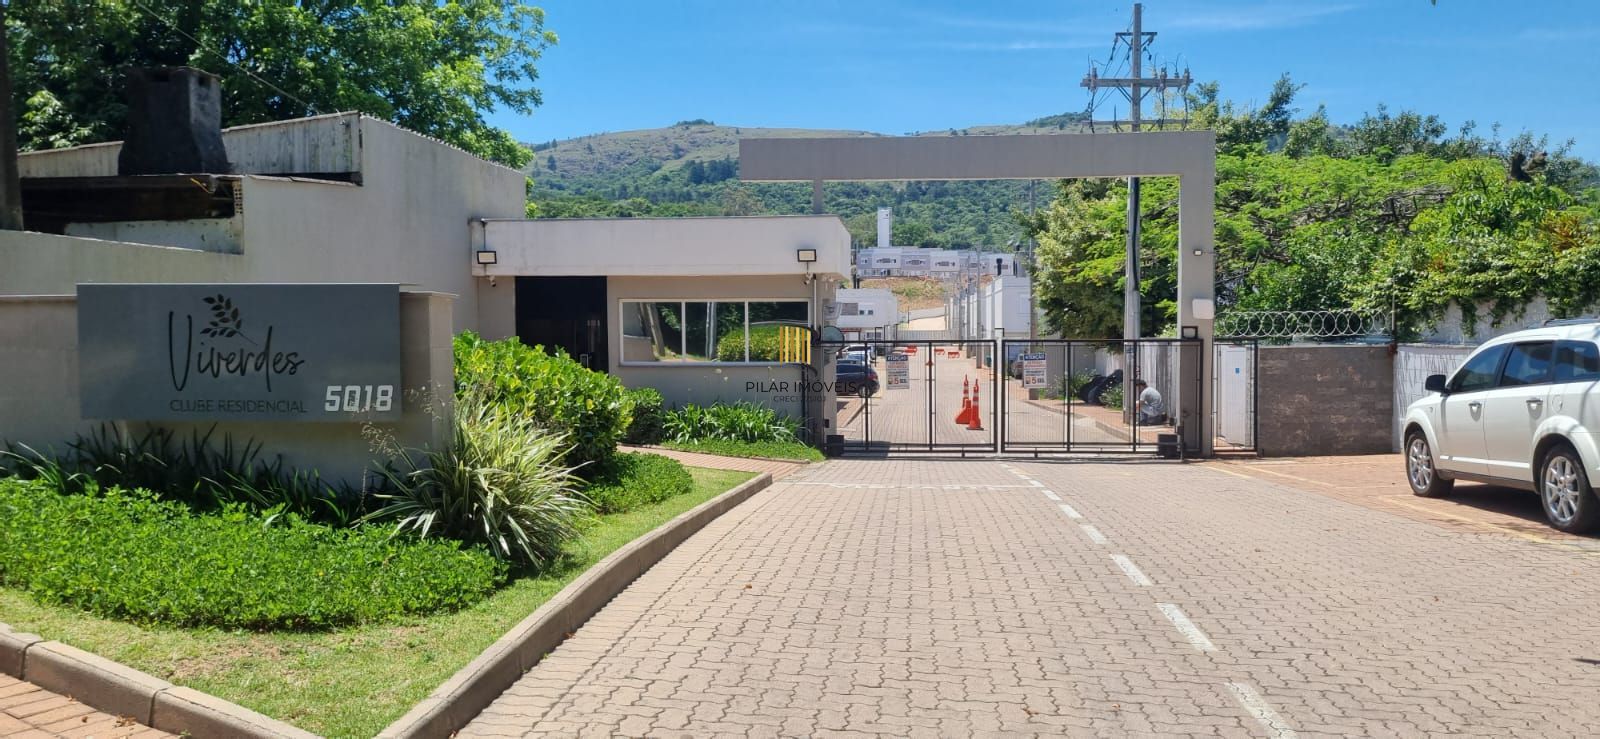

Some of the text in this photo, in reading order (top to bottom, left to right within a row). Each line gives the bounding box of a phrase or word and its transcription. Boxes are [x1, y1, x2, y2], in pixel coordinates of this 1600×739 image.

[168, 311, 305, 392] Viverdes
[169, 399, 308, 413] CLUBE RESIDENCIAL
[324, 385, 394, 412] 5018
